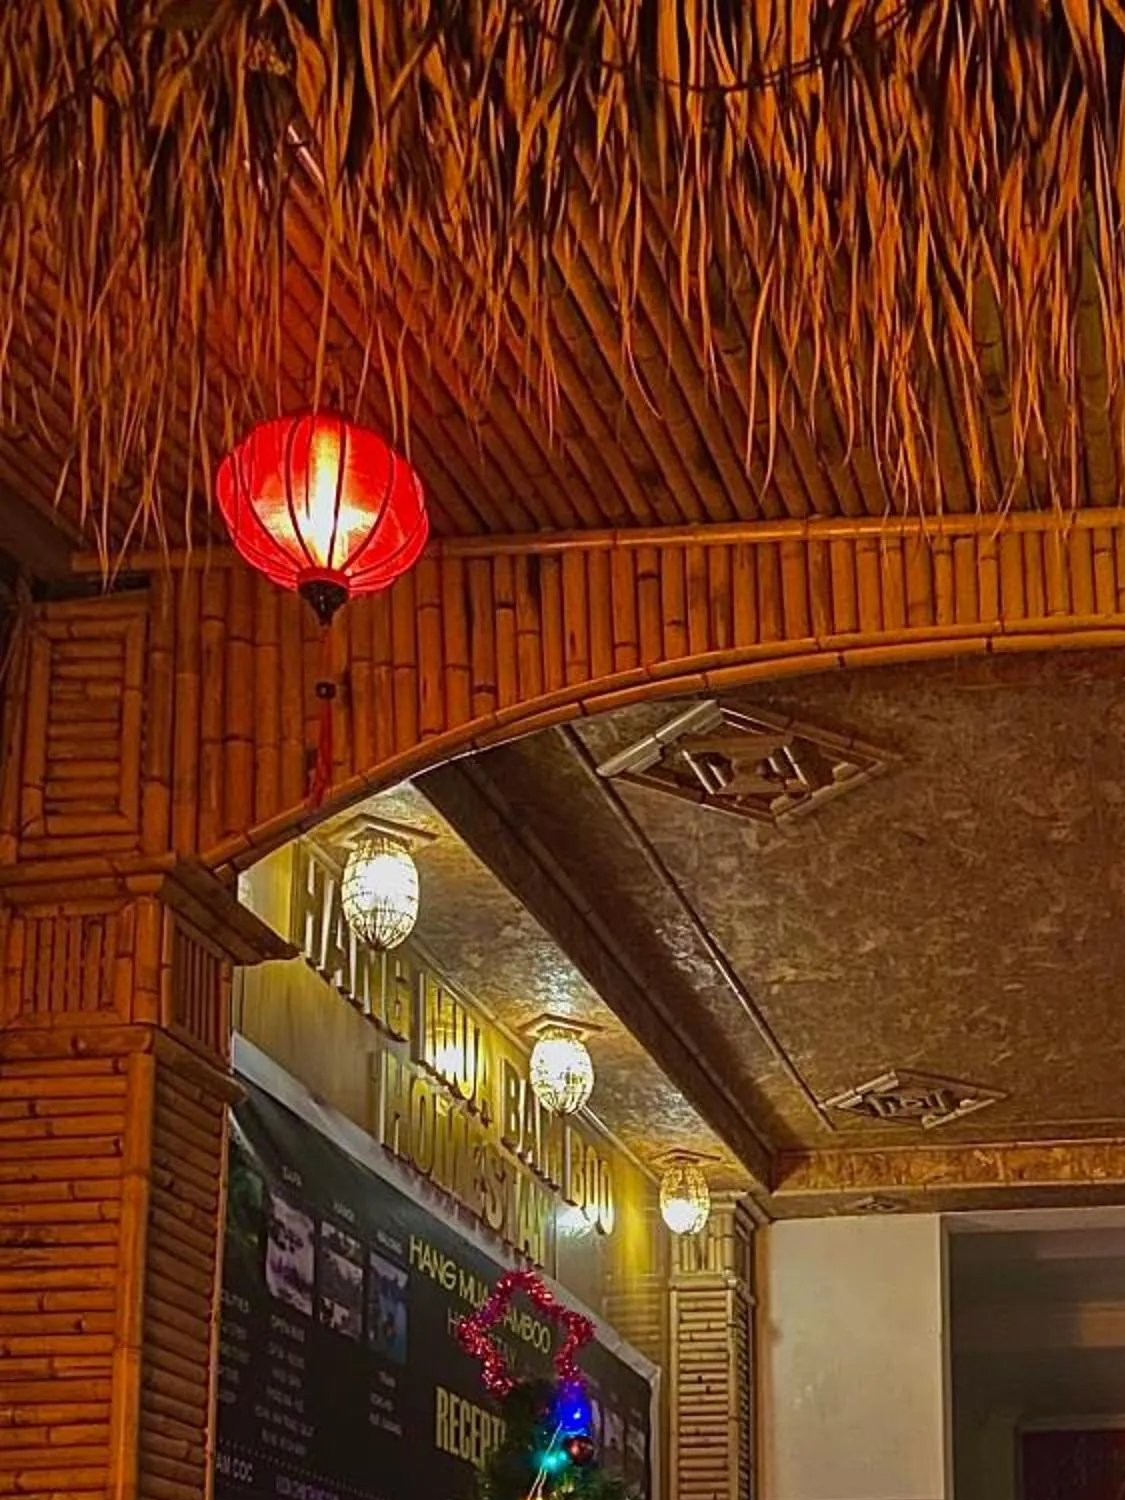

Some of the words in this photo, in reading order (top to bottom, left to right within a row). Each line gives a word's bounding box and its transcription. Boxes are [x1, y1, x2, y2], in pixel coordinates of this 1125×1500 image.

[409, 1234, 457, 1291] HANG
[459, 1269, 489, 1311] MU
[503, 1306, 552, 1354] AMBOO
[435, 1385, 507, 1473] RECEPTI
